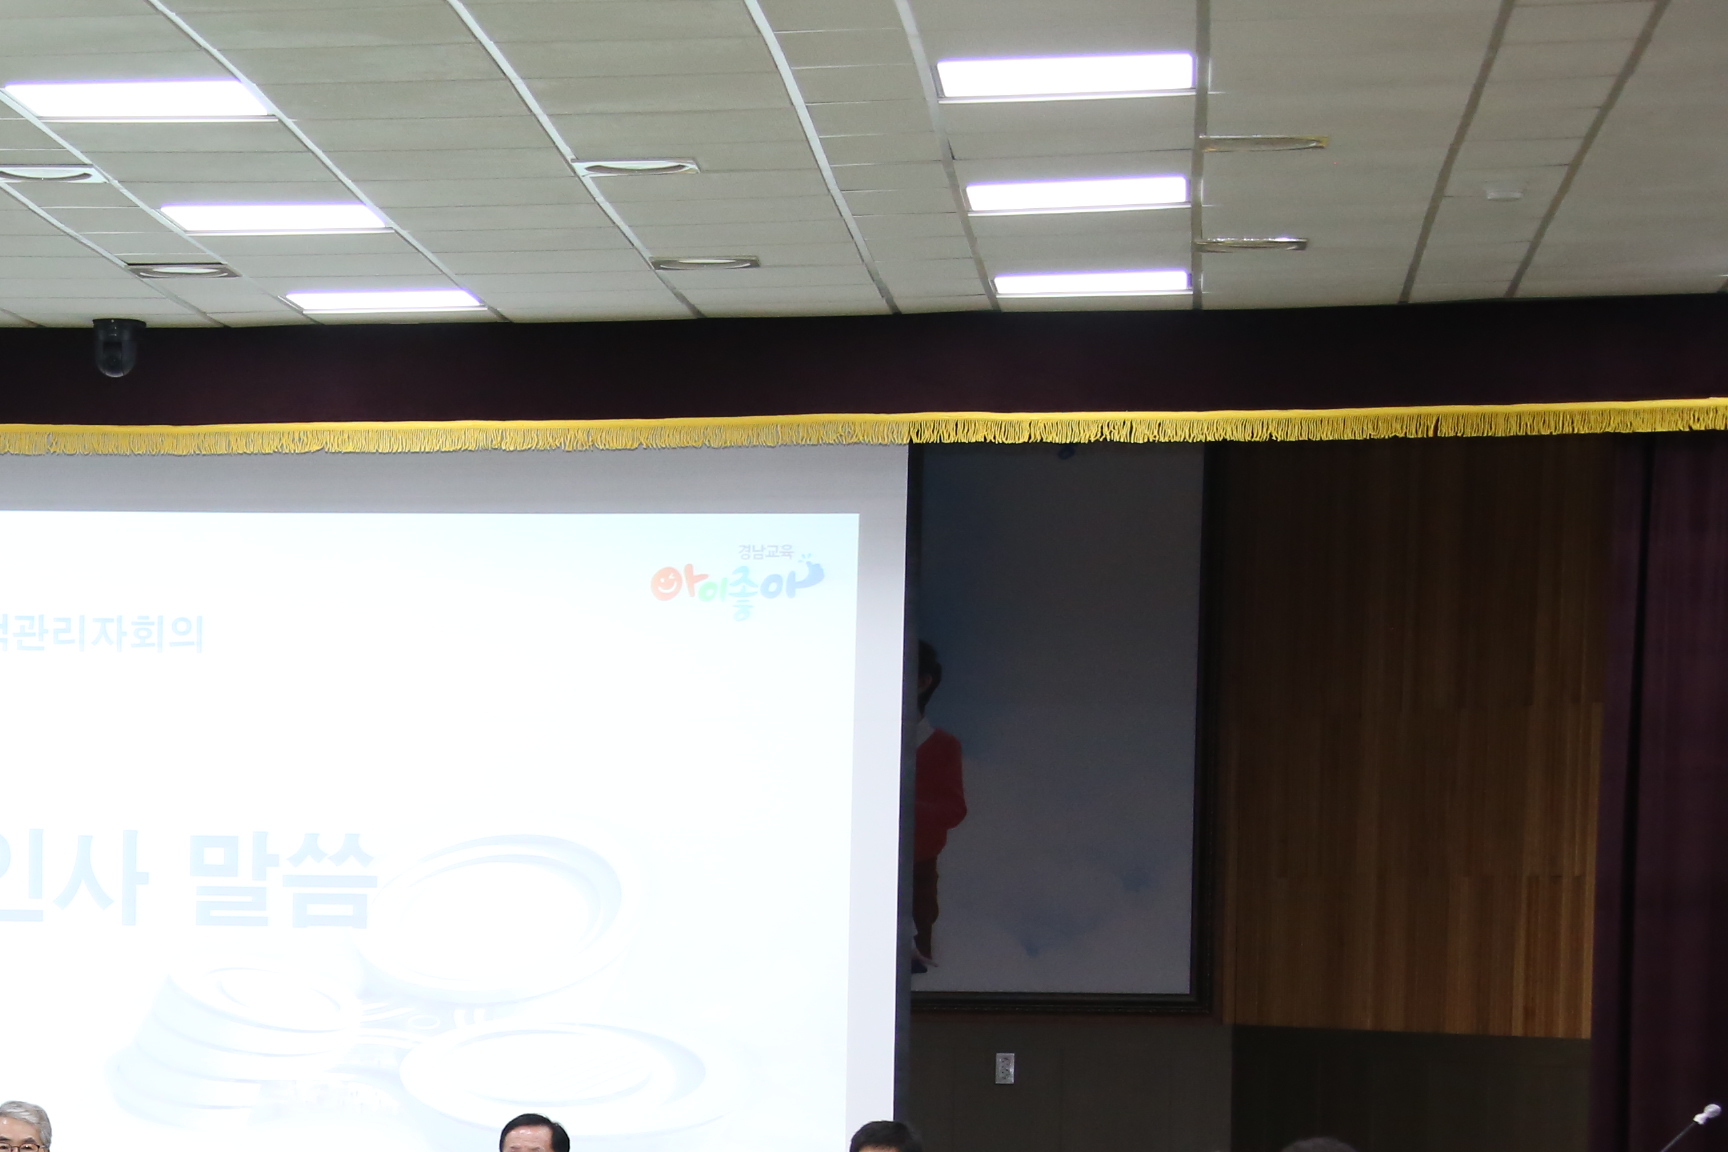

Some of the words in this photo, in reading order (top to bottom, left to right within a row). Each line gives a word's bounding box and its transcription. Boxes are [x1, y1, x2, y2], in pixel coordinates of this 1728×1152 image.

[738, 543, 795, 561] 경남교육
[650, 562, 826, 622] 아이좋아
[189, 830, 380, 930] 말씀
